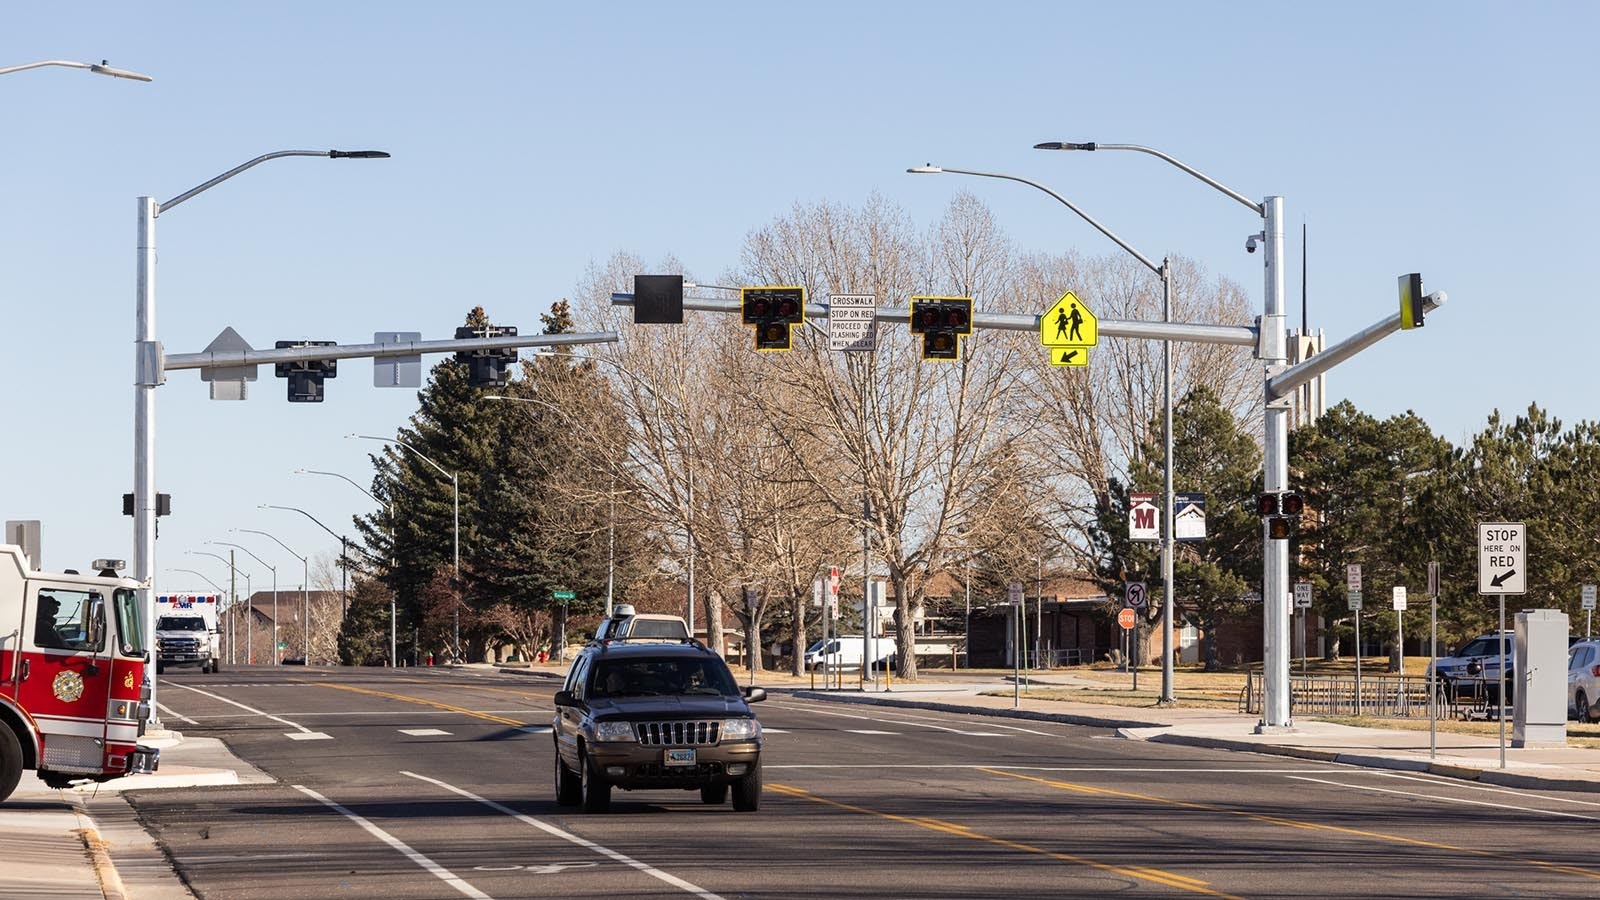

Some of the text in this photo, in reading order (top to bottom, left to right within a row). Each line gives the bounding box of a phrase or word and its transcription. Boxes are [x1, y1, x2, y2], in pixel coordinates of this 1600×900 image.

[832, 297, 873, 305] CROSSWALK
[831, 310, 874, 319] STOP ON RED
[832, 322, 873, 330] PROCEED ON
[831, 331, 874, 339] FLASHING RED
[832, 340, 873, 348] WHEN CLEAR
[1135, 508, 1155, 529] M
[1486, 529, 1518, 541] STOP
[1484, 544, 1521, 552] HERE ON
[1489, 556, 1515, 567] RED
